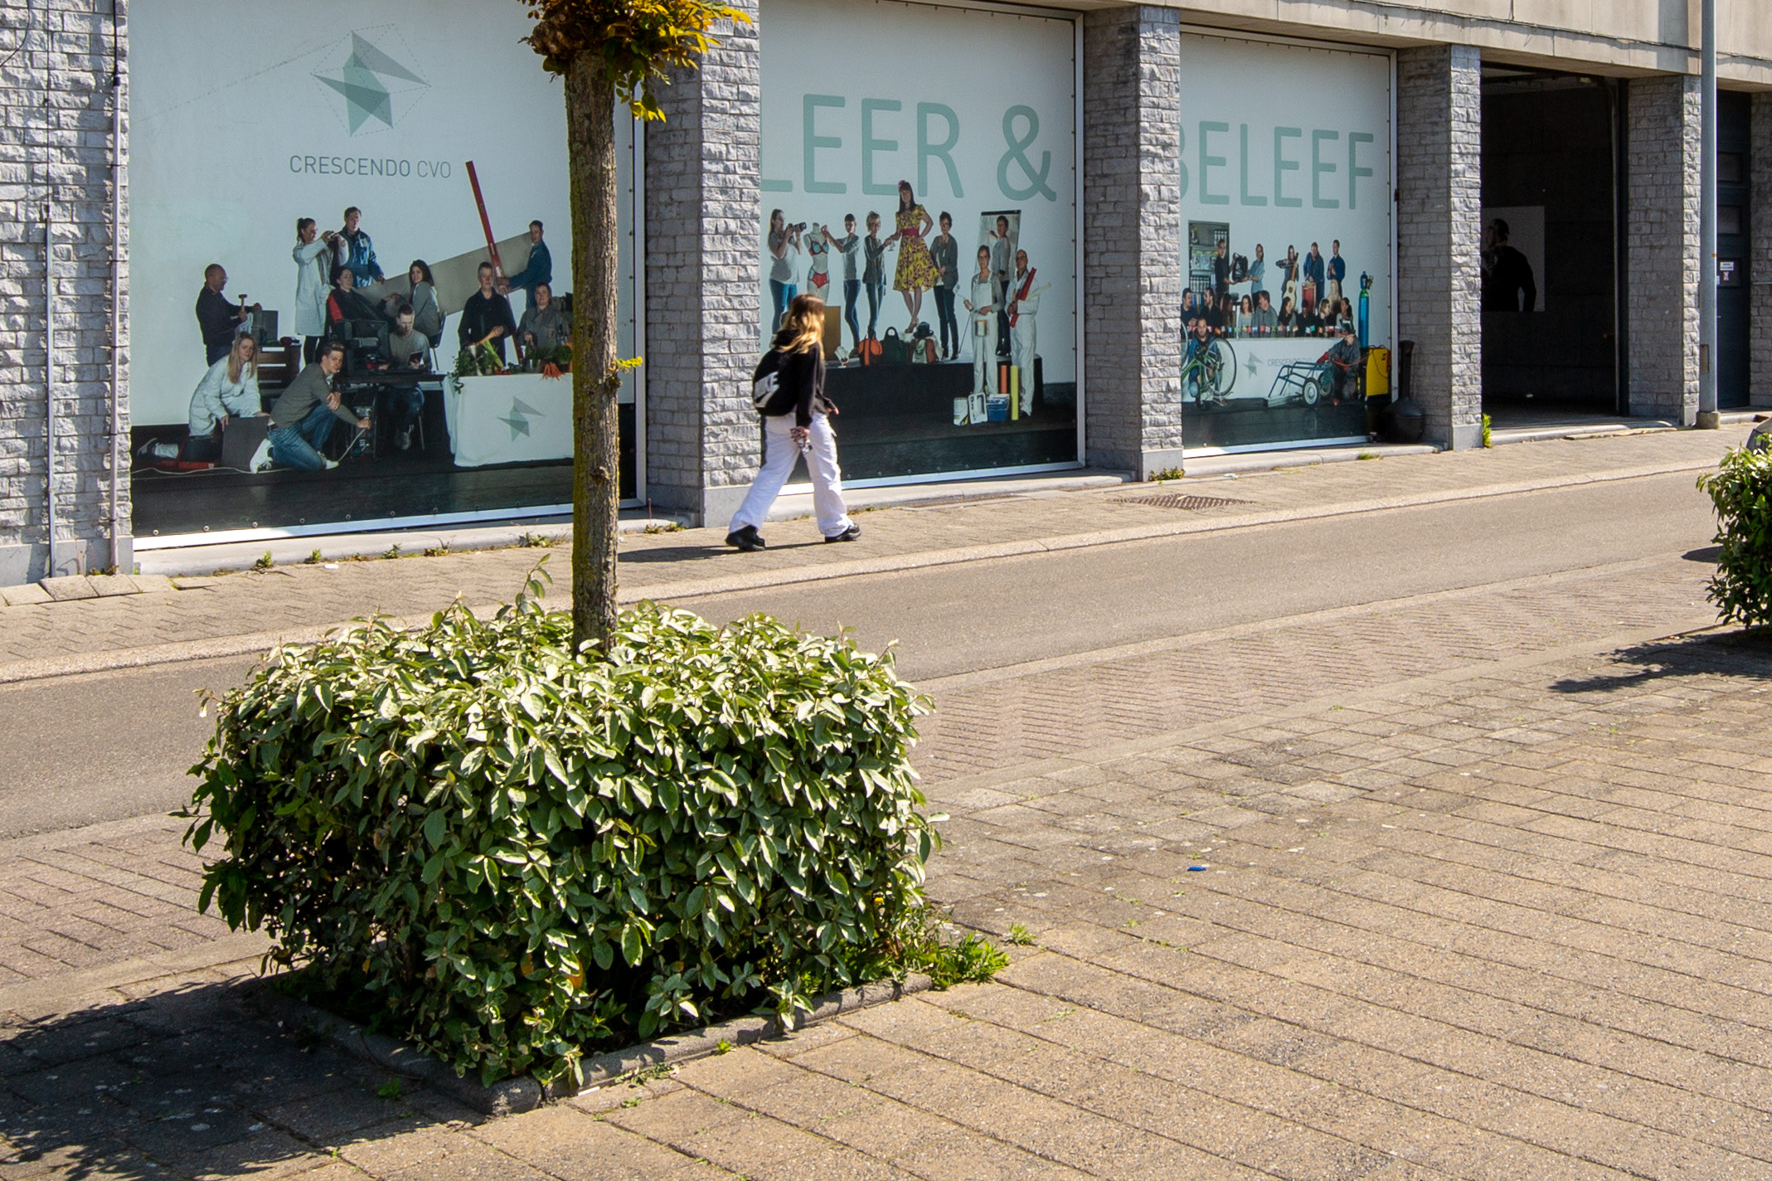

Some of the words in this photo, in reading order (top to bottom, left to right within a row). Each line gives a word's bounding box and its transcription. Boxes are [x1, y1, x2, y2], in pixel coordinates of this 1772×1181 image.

[289, 154, 411, 178] CRESCENDO
[417, 160, 451, 179] CVO
[996, 104, 1057, 202] &
